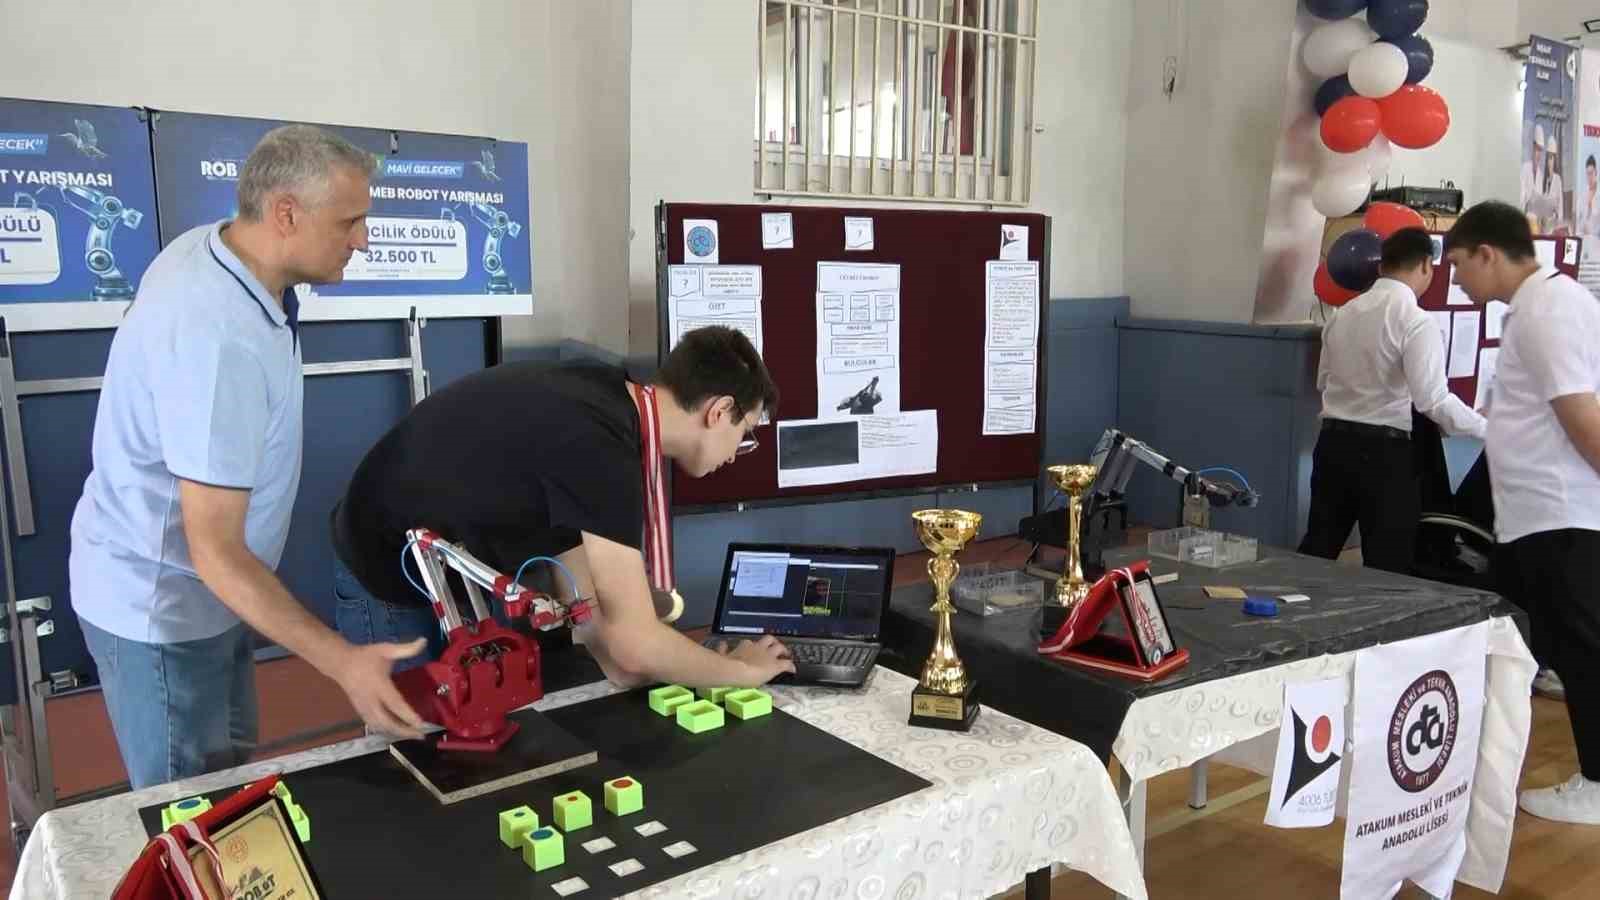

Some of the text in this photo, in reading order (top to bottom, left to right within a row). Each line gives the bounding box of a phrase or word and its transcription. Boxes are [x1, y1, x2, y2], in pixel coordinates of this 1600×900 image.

[387, 163, 411, 174] MAVİ
[12, 169, 113, 188] YARIŞMASI
[369, 186, 504, 204] MEB ROBOT YARIŞMASI
[0, 215, 41, 232] ÜLÜ
[367, 223, 456, 240] CİLİK ÖDÜLÜ
[365, 249, 437, 264] 32.500 TL
[1356, 814, 1396, 838] ATAKUM
[1397, 797, 1433, 826] MESLEKİ
[1433, 795, 1443, 810] VE
[1382, 809, 1449, 852] ANADOLU LİSESİ
